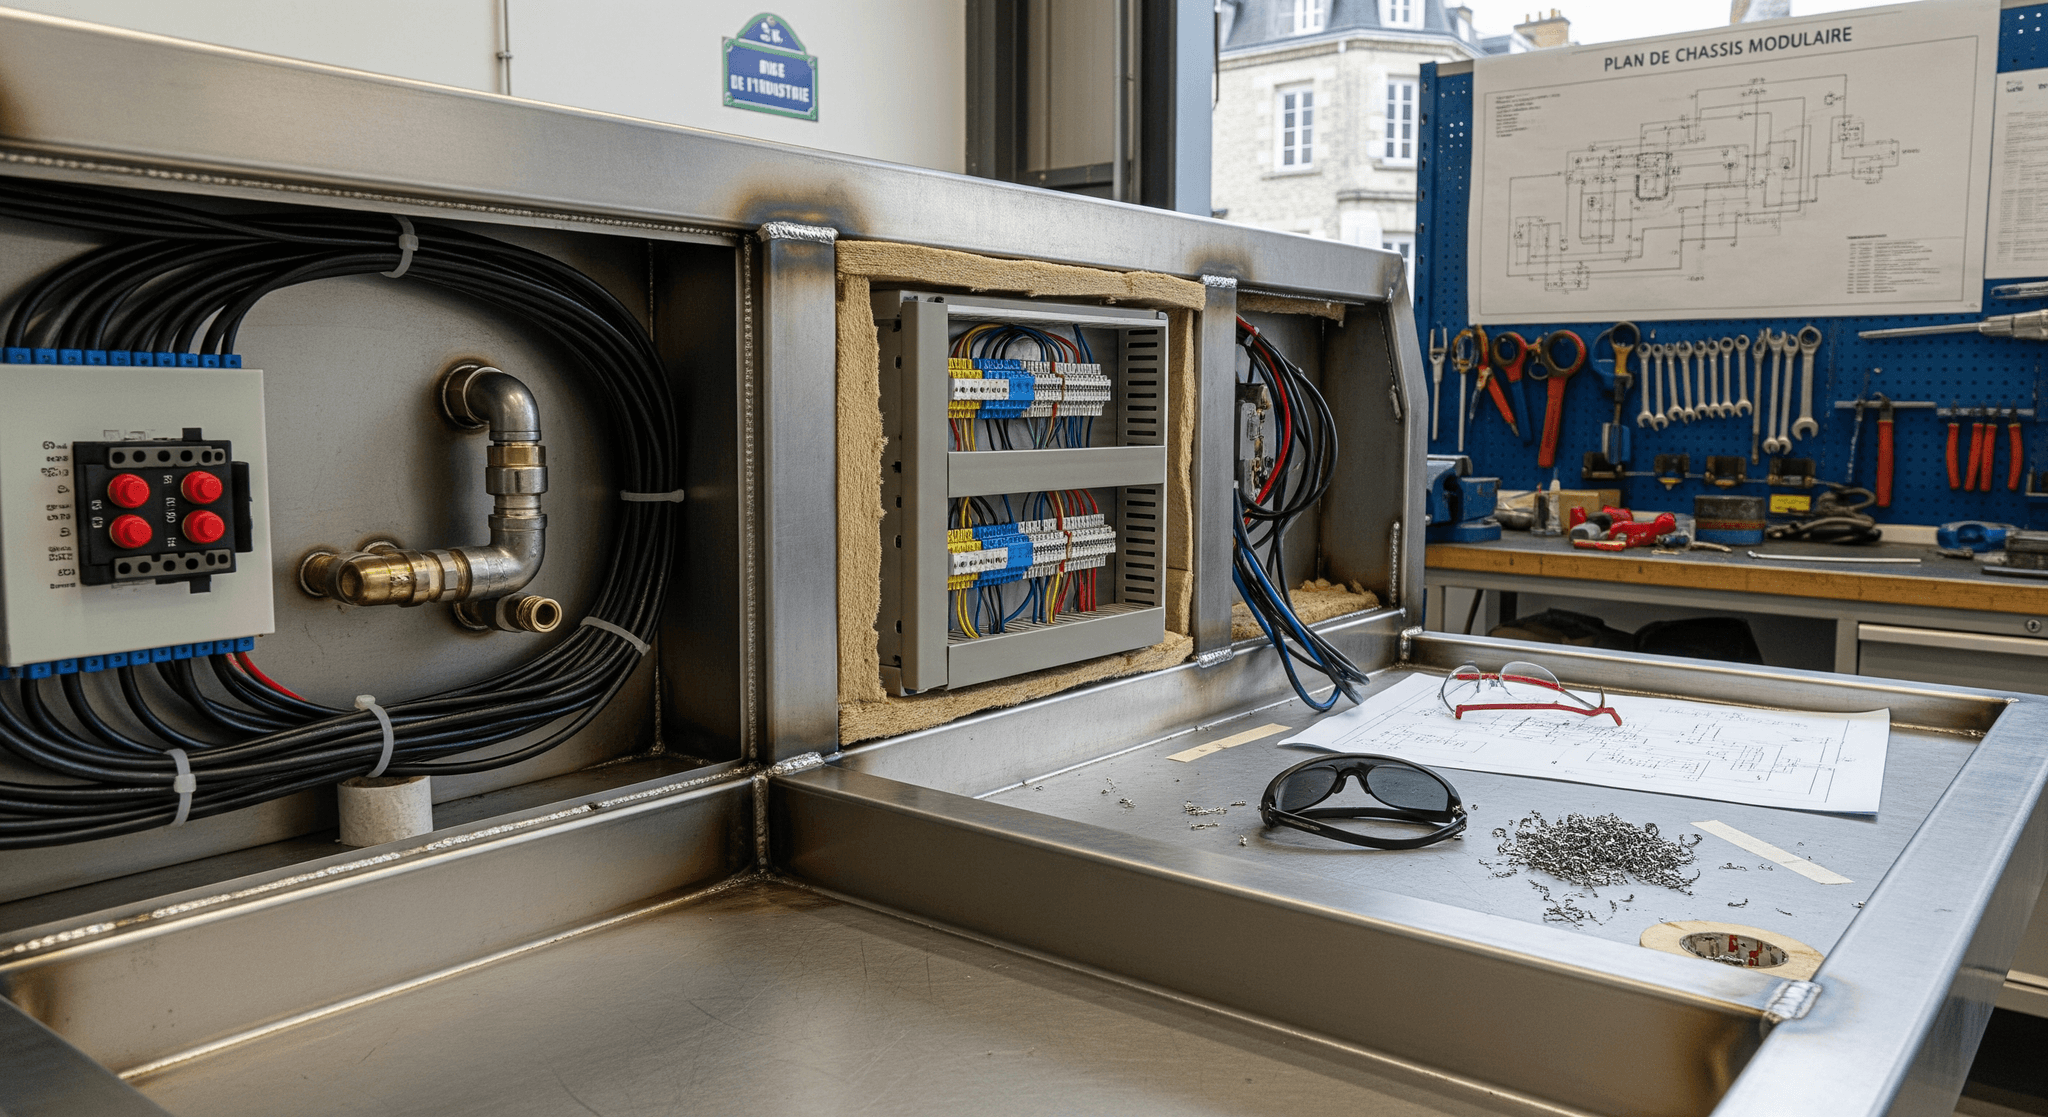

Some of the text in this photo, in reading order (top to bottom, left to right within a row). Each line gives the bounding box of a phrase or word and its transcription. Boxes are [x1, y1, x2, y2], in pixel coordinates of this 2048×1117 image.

[1604, 26, 1852, 72] PLAN DE CHASSIS MODULAIRE
